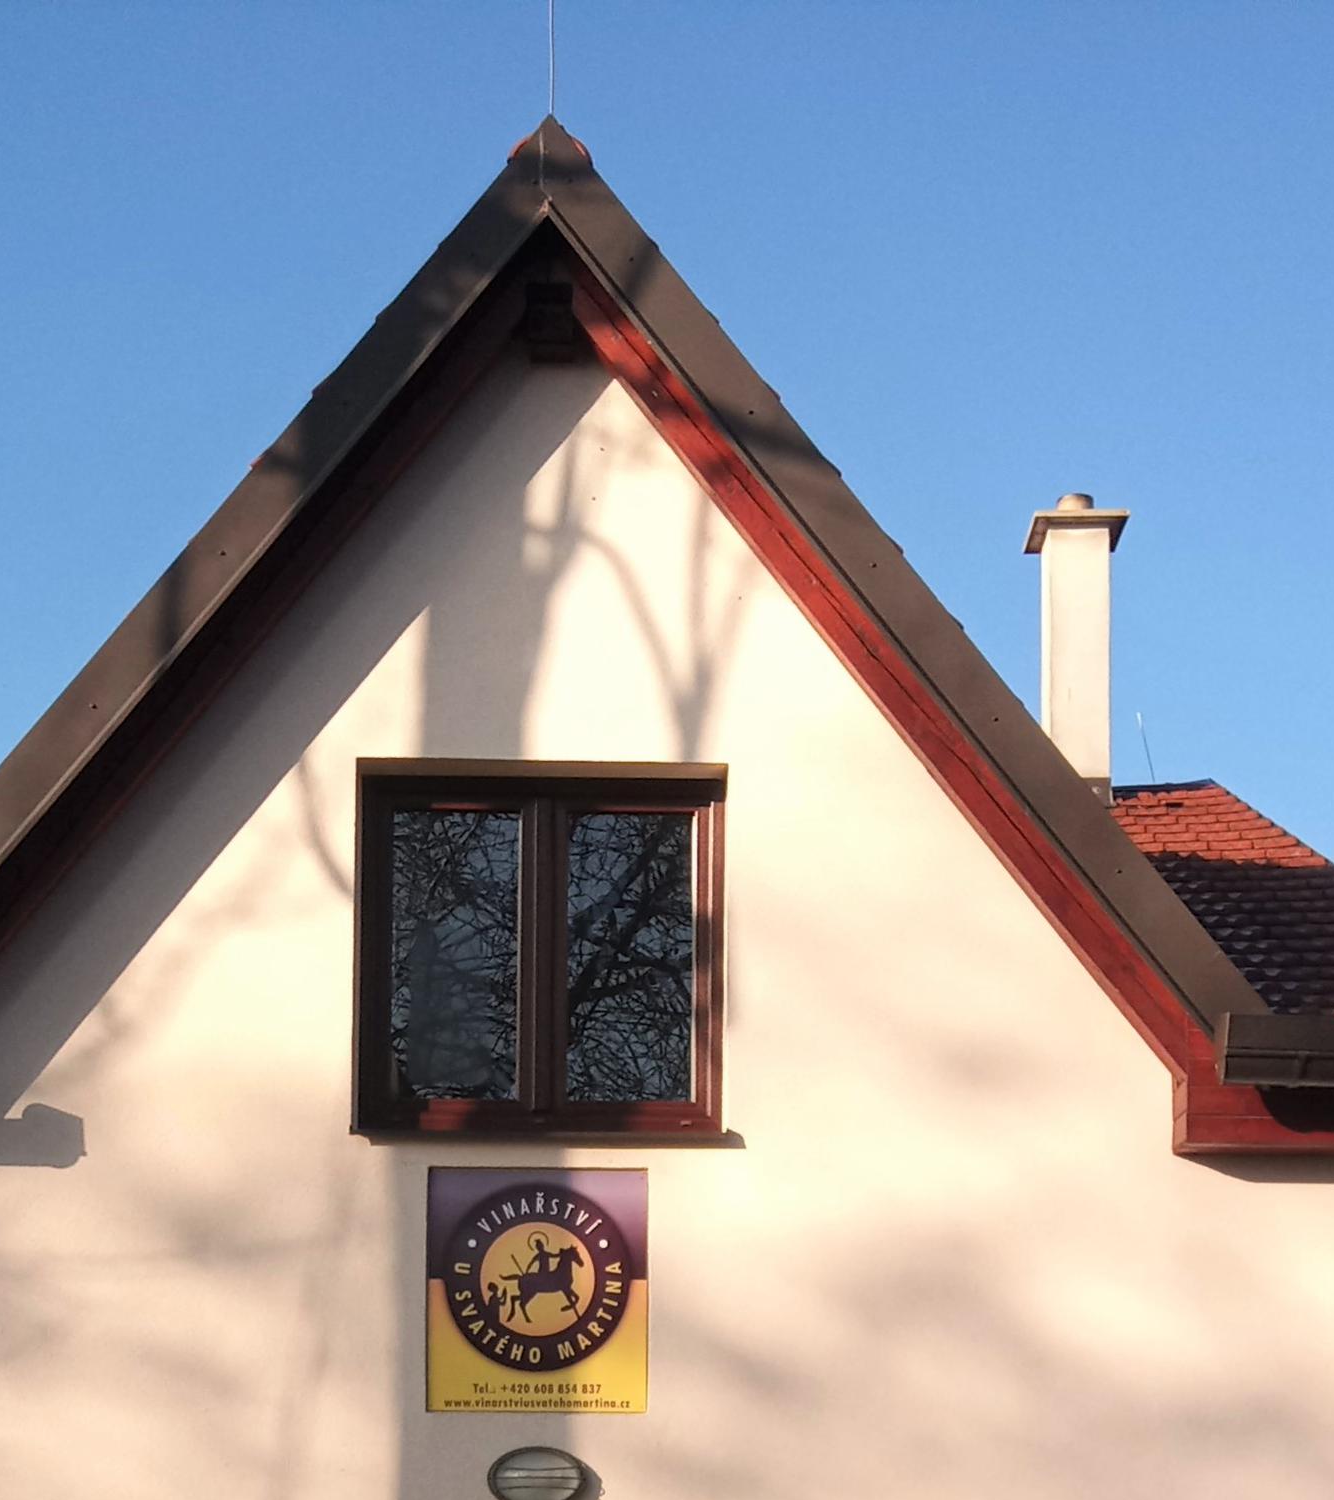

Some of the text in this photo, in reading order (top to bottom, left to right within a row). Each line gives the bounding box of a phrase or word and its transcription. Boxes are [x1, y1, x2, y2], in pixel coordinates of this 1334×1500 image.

[477, 1192, 603, 1234] VINAŘSTVÍ
[454, 1261, 623, 1364] U SVATÉHO MARTINA
[500, 1384, 530, 1395] +420
[534, 1384, 555, 1395] 608
[558, 1384, 578, 1395] 854
[582, 1384, 602, 1395] 837
